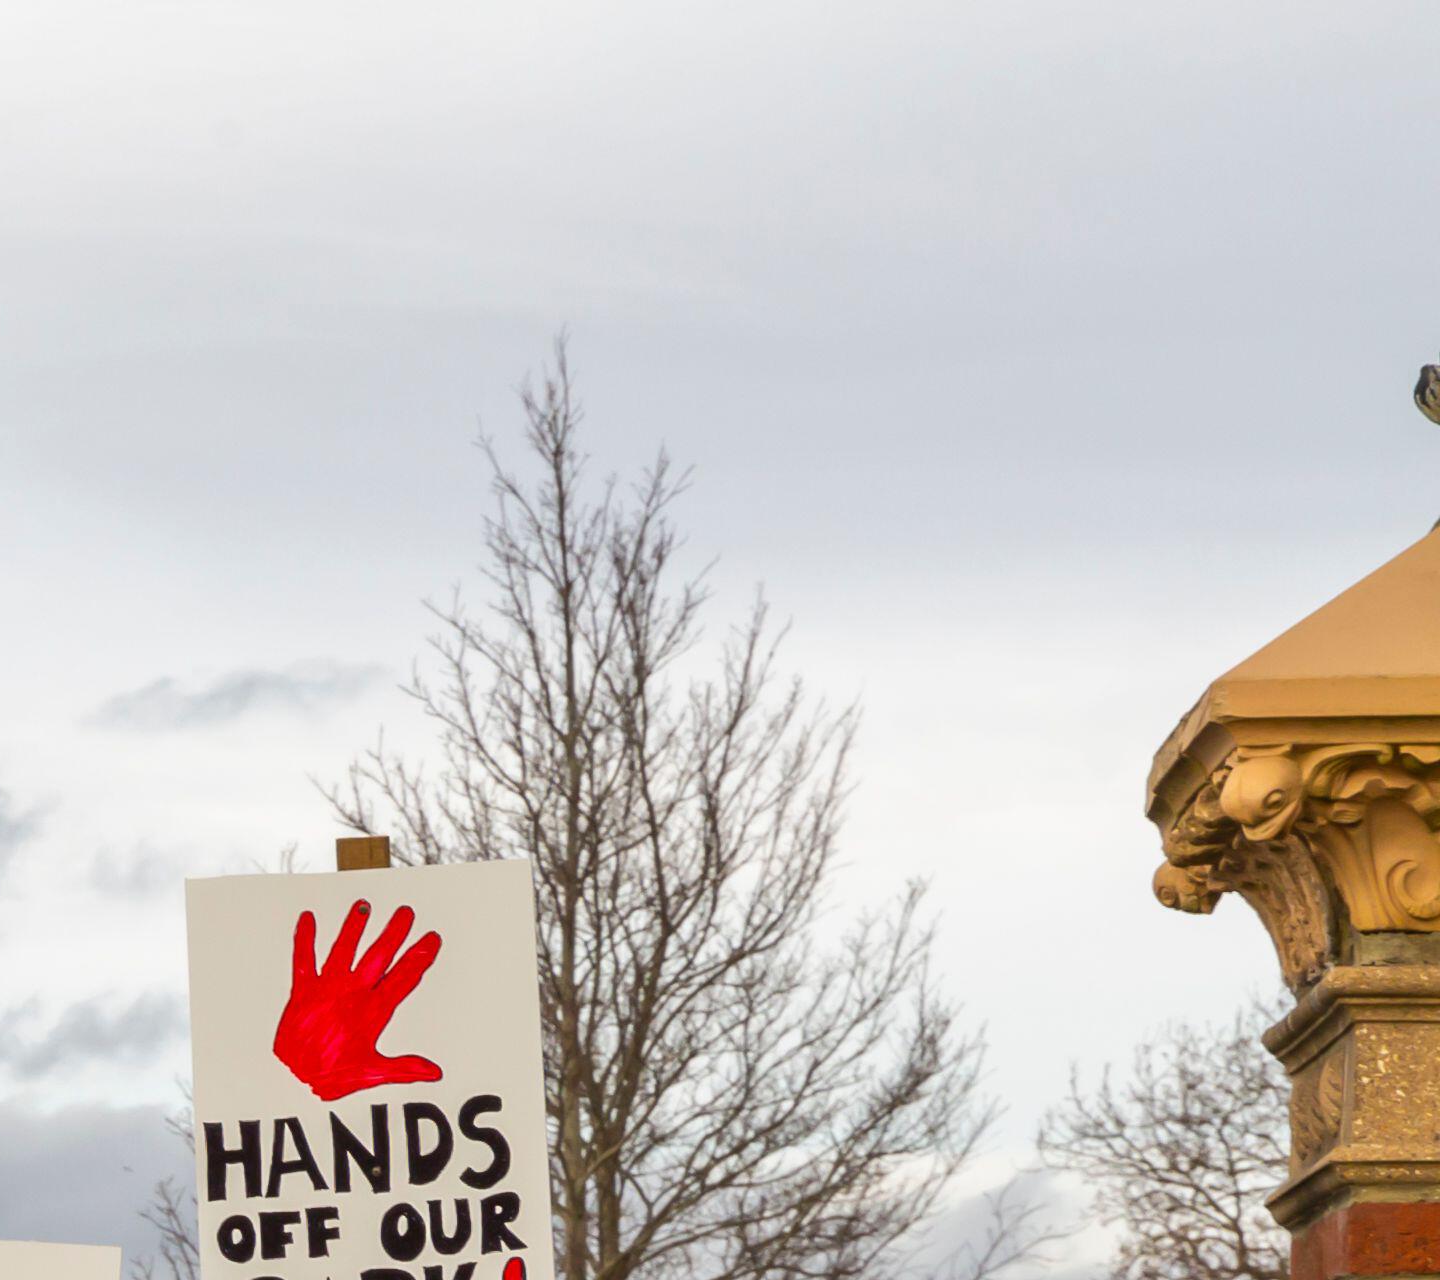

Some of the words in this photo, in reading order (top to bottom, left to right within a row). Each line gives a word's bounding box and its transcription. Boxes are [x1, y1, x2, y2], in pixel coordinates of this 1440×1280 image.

[203, 1094, 512, 1202] HANDS
[217, 1206, 340, 1263] OFF
[380, 1191, 528, 1262] OUR
